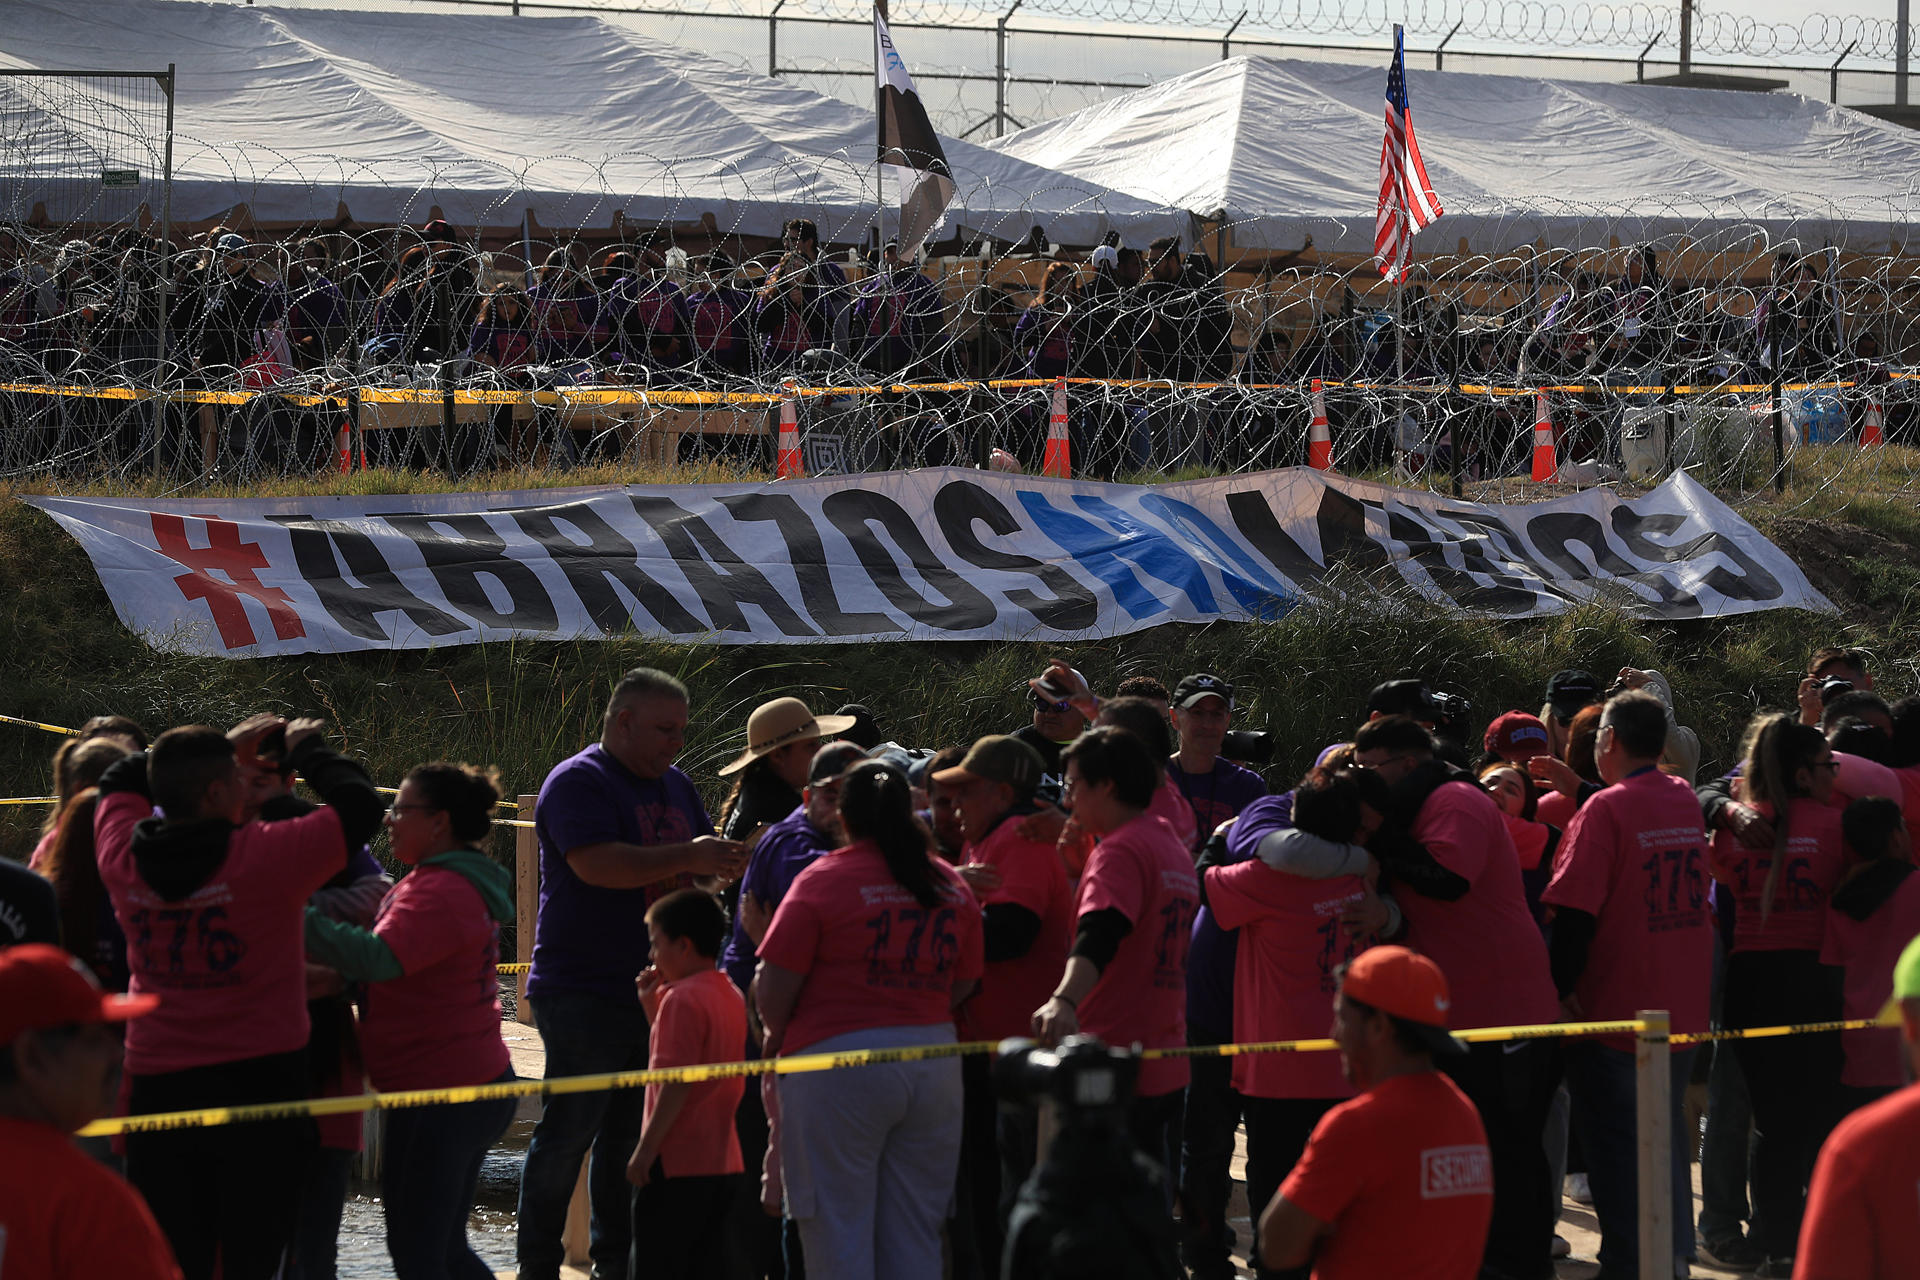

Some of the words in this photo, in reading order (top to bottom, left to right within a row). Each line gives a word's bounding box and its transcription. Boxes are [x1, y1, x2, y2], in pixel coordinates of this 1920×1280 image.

[1642, 849, 1702, 913] 176
[131, 908, 247, 972] 176
[864, 909, 959, 973] 176
